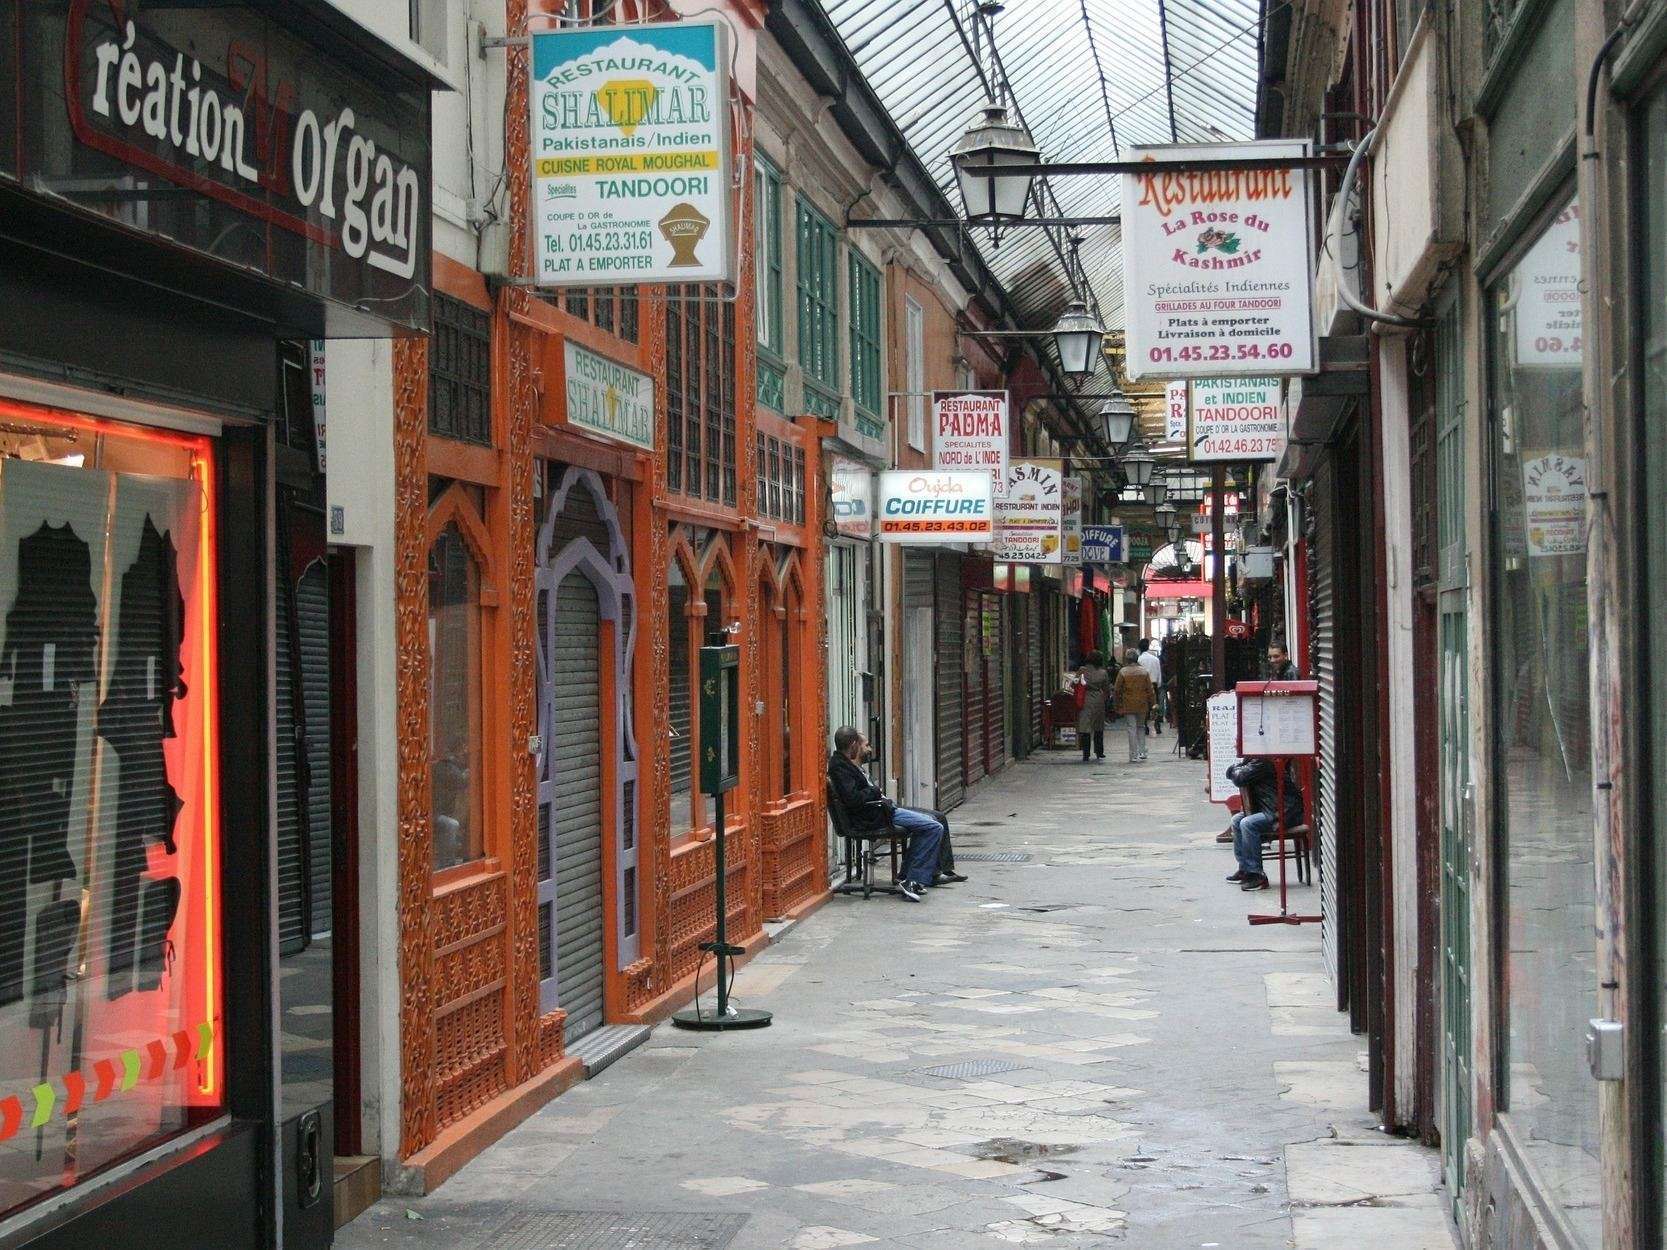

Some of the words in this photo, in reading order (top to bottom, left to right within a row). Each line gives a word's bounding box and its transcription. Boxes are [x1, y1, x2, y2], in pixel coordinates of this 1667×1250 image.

[547, 57, 700, 89] RESTAURANT
[542, 84, 710, 130] SHALIMAR
[542, 158, 589, 175] CUISNE
[596, 156, 637, 172] ROYAL
[643, 153, 709, 170] MOUGHAL
[596, 176, 708, 199] TANDOORI
[547, 213, 575, 221] COUPE
[591, 220, 651, 229] GASTRONOMIE
[1161, 219, 1187, 236] La
[1190, 210, 1239, 225] Rose
[1244, 214, 1270, 233] du
[545, 234, 564, 253] Tel.
[569, 231, 652, 252] 01.45.23.31.61
[545, 258, 571, 272] PLAT
[577, 258, 584, 271] A
[589, 255, 652, 270] EMPORTER
[1172, 248, 1262, 270] Kashmir
[1147, 280, 1220, 298] Spécialités
[1226, 279, 1290, 293] Indiennes
[1155, 301, 1197, 311] GRILLADES
[1200, 301, 1211, 310] AU
[1214, 300, 1236, 309] FOUR
[1239, 299, 1281, 309] TANDOORI
[1168, 319, 1199, 327] Plats
[1202, 318, 1208, 326] à
[1211, 316, 1269, 328] emporter
[1158, 329, 1216, 339] Livraison
[1219, 328, 1226, 337] à
[1229, 327, 1281, 337] domicile
[1149, 343, 1293, 363] 01.45.23.54.60
[575, 350, 640, 399] RESTAURANT
[941, 400, 1000, 412] RESTAURANT
[1205, 395, 1216, 405] et
[1222, 392, 1266, 404] INDIEN
[568, 378, 650, 444] SHALIMAR
[1196, 406, 1278, 422] TANDOORI
[940, 413, 1002, 436] PADMA
[1196, 425, 1214, 434] COUPE
[1240, 423, 1278, 433] GASTRONOMIE
[939, 451, 962, 464] NORD
[964, 451, 972, 464] de
[1009, 467, 1057, 495] ASMIN
[884, 522, 987, 531] 01.45.23.43.02
[1080, 529, 1119, 548] OIFFURE
